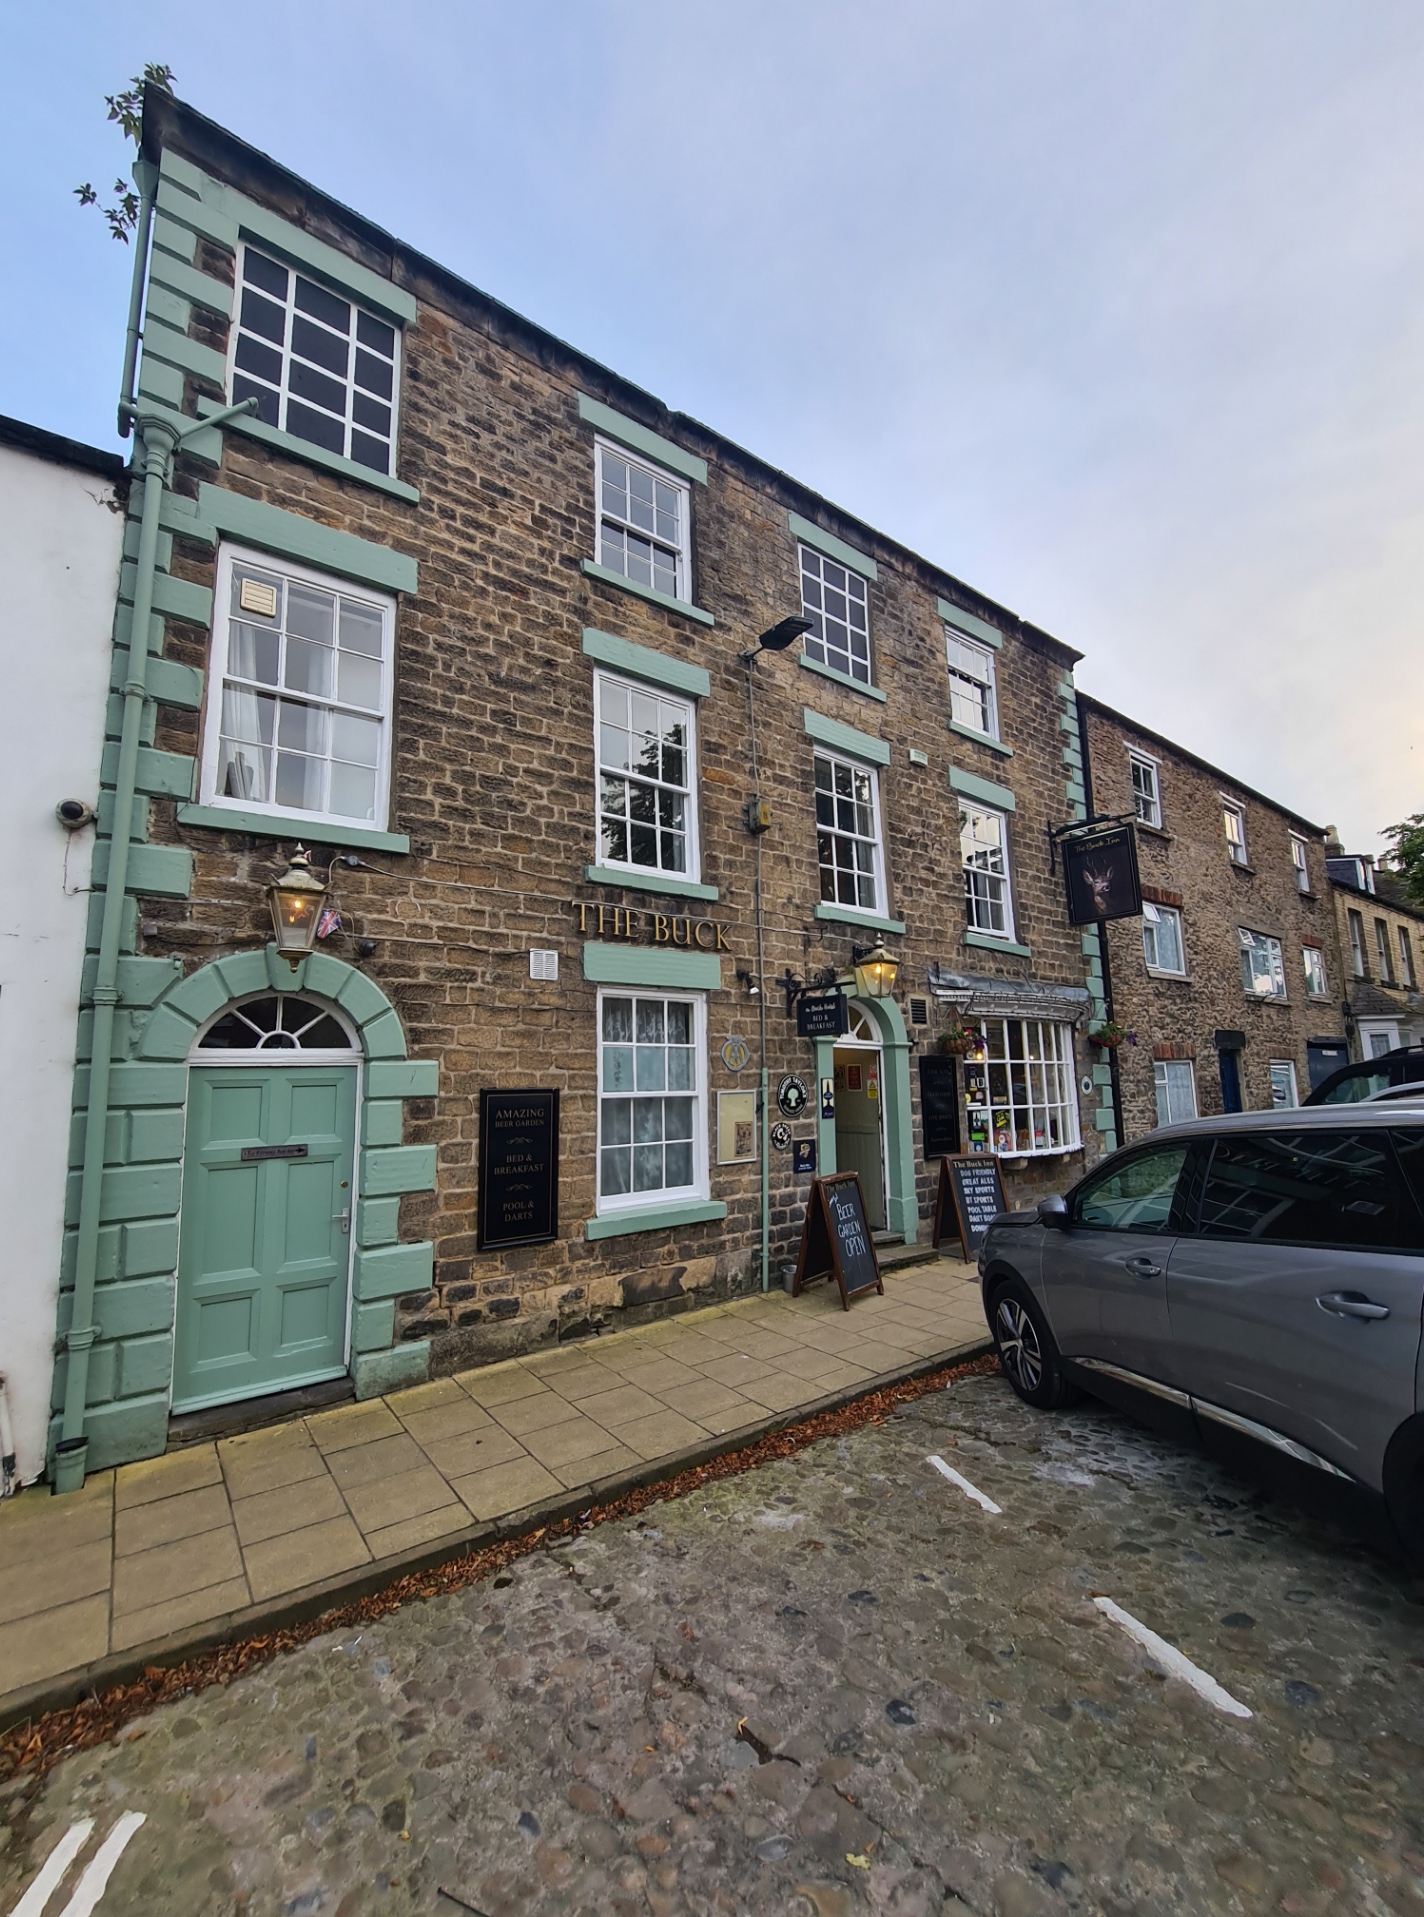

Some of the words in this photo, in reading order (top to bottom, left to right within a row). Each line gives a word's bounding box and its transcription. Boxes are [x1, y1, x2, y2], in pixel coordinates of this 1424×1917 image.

[1074, 845, 1086, 853] The
[1086, 841, 1104, 851] Buck
[1105, 837, 1120, 846] Inn
[572, 900, 639, 938] THE
[655, 914, 733, 950] BUCK
[807, 1021, 836, 1030] BREAKFAST
[495, 1108, 545, 1119] AMAZING
[495, 1120, 514, 1128] BEER
[515, 1119, 545, 1127] GARDEN
[506, 1154, 524, 1163] BED
[526, 1154, 533, 1162] &
[494, 1163, 545, 1175] BREAKFAST
[960, 1169, 971, 1177] DOG
[972, 1168, 996, 1176] FRIENDLY
[962, 1178, 979, 1186] GREAT
[963, 1187, 973, 1195] SKY
[975, 1186, 995, 1194] SPORTS
[503, 1201, 526, 1211] POOL
[527, 1200, 535, 1208] &
[967, 1206, 981, 1214] POOL
[982, 1205, 997, 1213] TABLE
[504, 1211, 533, 1222] DARTS
[836, 1203, 856, 1220] BEER
[969, 1215, 983, 1223] DART
[837, 1220, 861, 1238] GARDEN
[845, 1235, 866, 1257] OPEN
